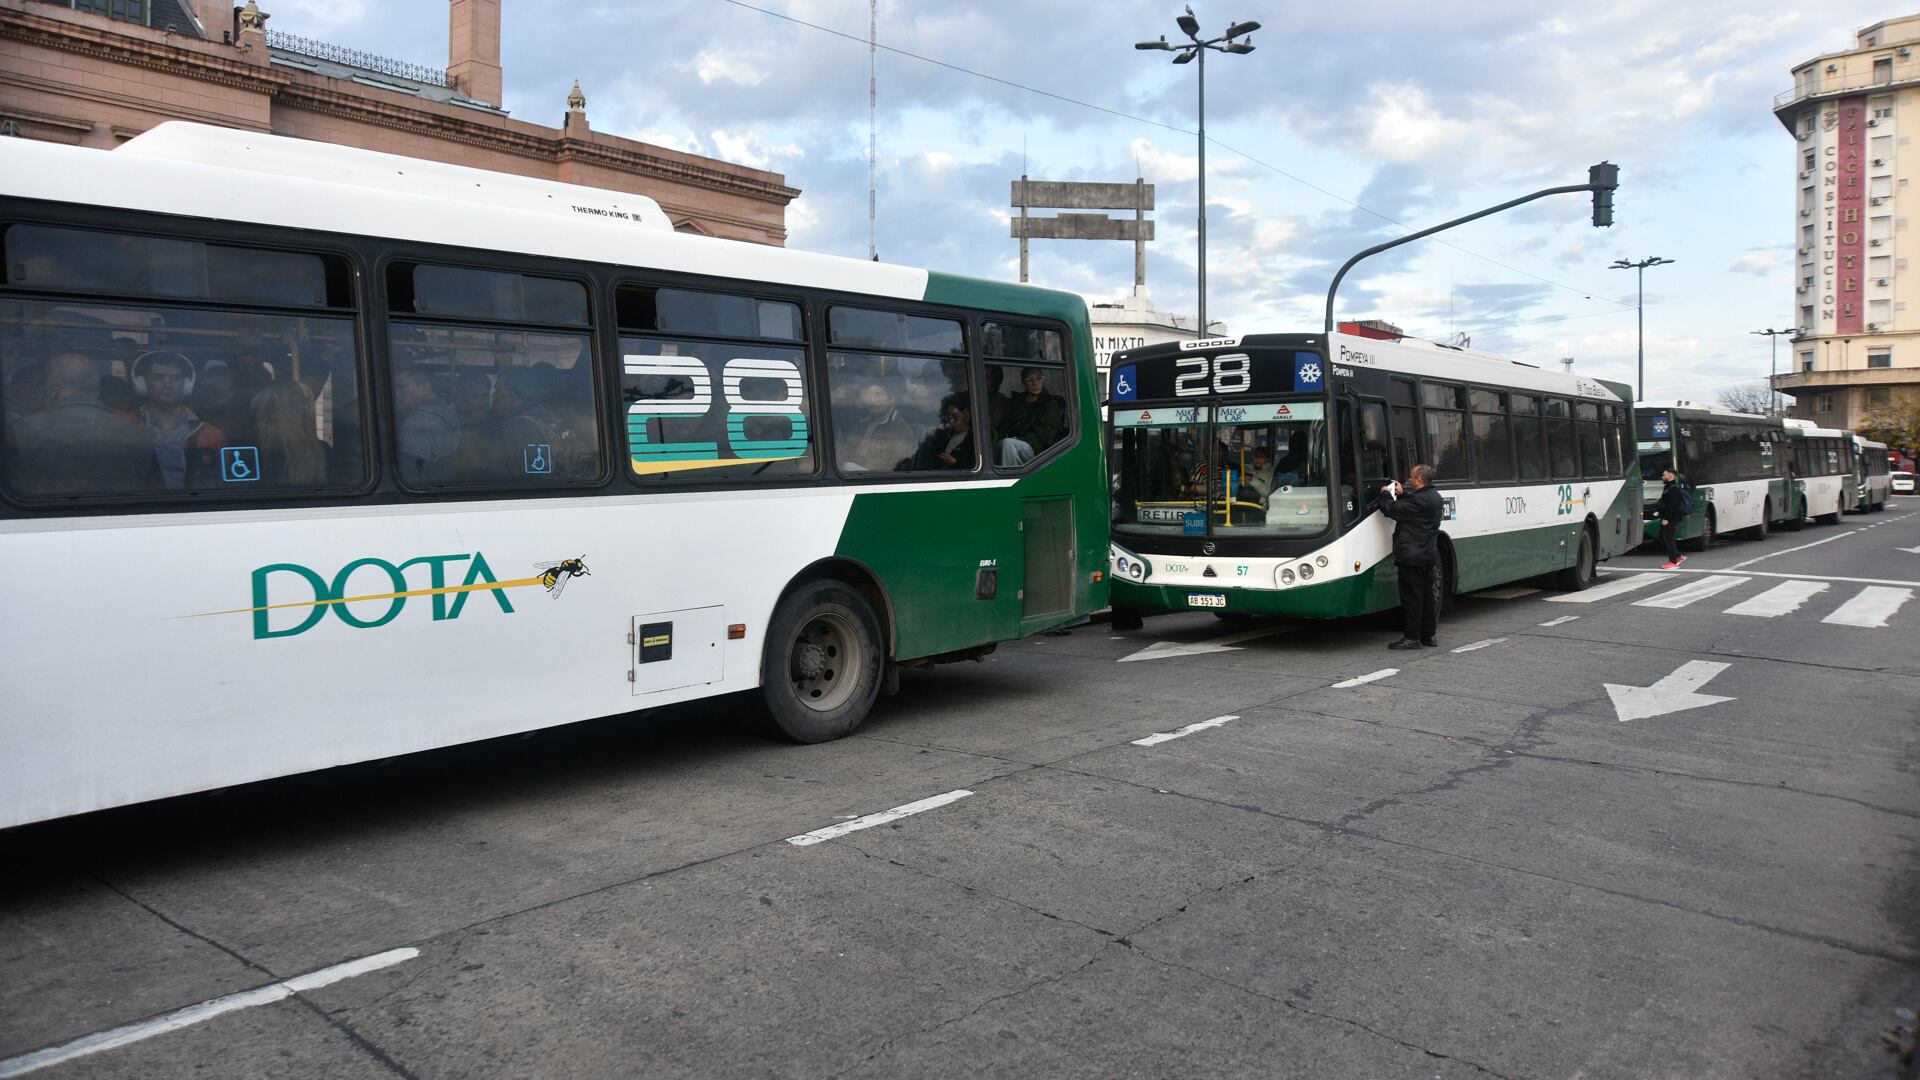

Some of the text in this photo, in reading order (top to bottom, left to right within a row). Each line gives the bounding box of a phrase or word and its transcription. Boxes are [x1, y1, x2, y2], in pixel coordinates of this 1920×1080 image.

[571, 205, 629, 220] THERMO KING
[1823, 146, 1836, 320] CONSTITUCION
[1843, 208, 1859, 317] HOTEL
[1175, 353, 1251, 397] 28
[623, 354, 808, 464] 28
[1220, 408, 1247, 416] MEGA
[1142, 510, 1189, 520] RETIR
[1558, 485, 1573, 515] 28
[1237, 566, 1249, 576] 57
[251, 551, 515, 640] DOTA
[1189, 597, 1199, 605] AB
[1215, 598, 1225, 606] JC
